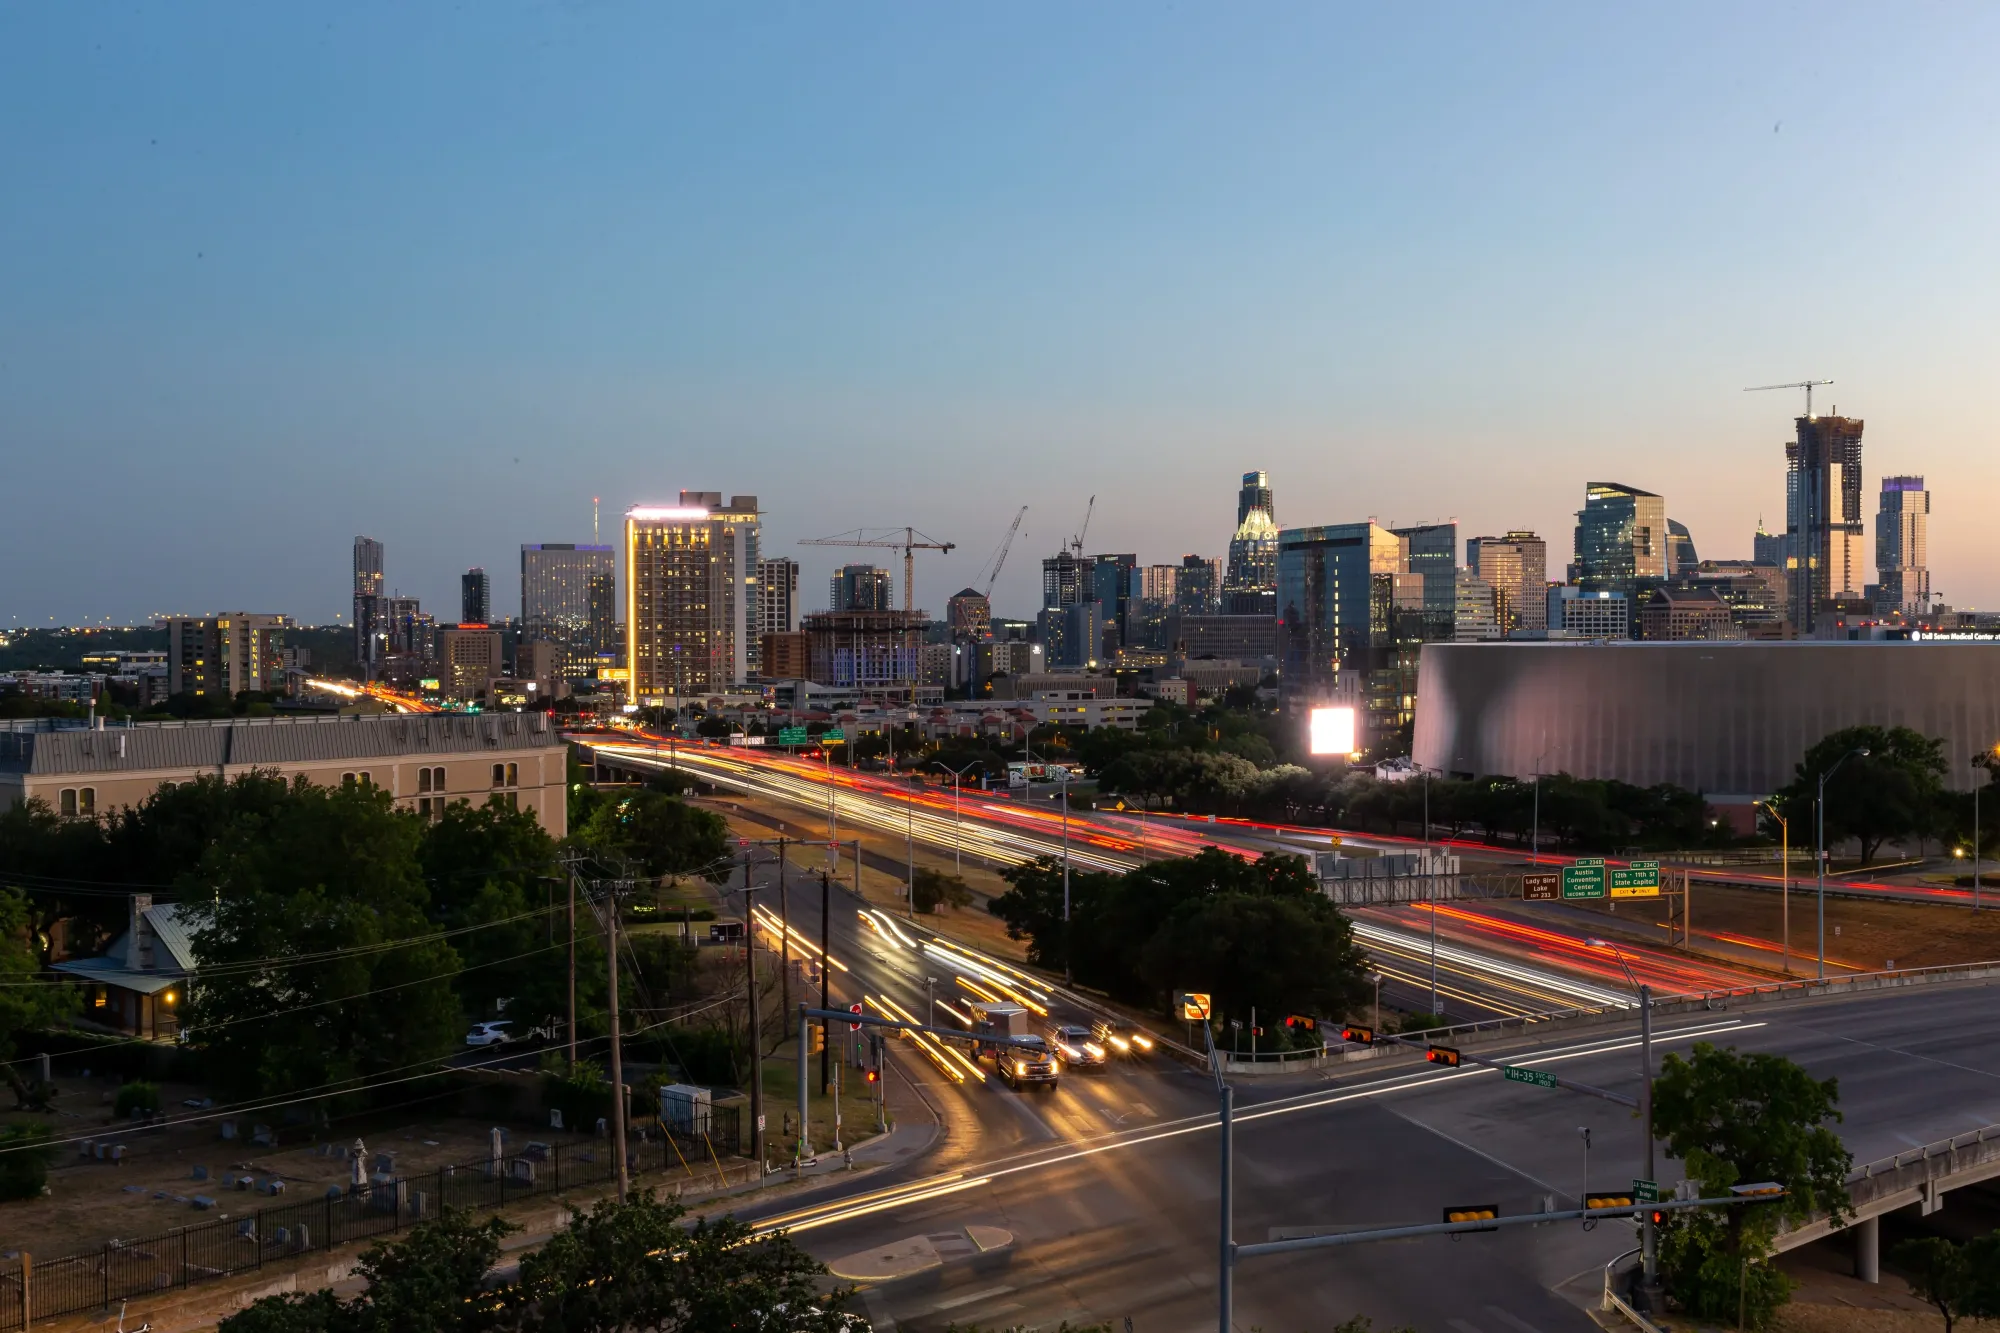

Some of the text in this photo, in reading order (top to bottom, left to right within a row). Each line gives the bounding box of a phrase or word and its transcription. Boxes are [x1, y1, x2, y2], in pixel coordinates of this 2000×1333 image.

[1922, 632, 1933, 640] Dell
[1934, 632, 1950, 640] Seton
[1951, 632, 1973, 640] Medical
[1974, 632, 1994, 640] Center
[1511, 1069, 1534, 1081] IH-35
